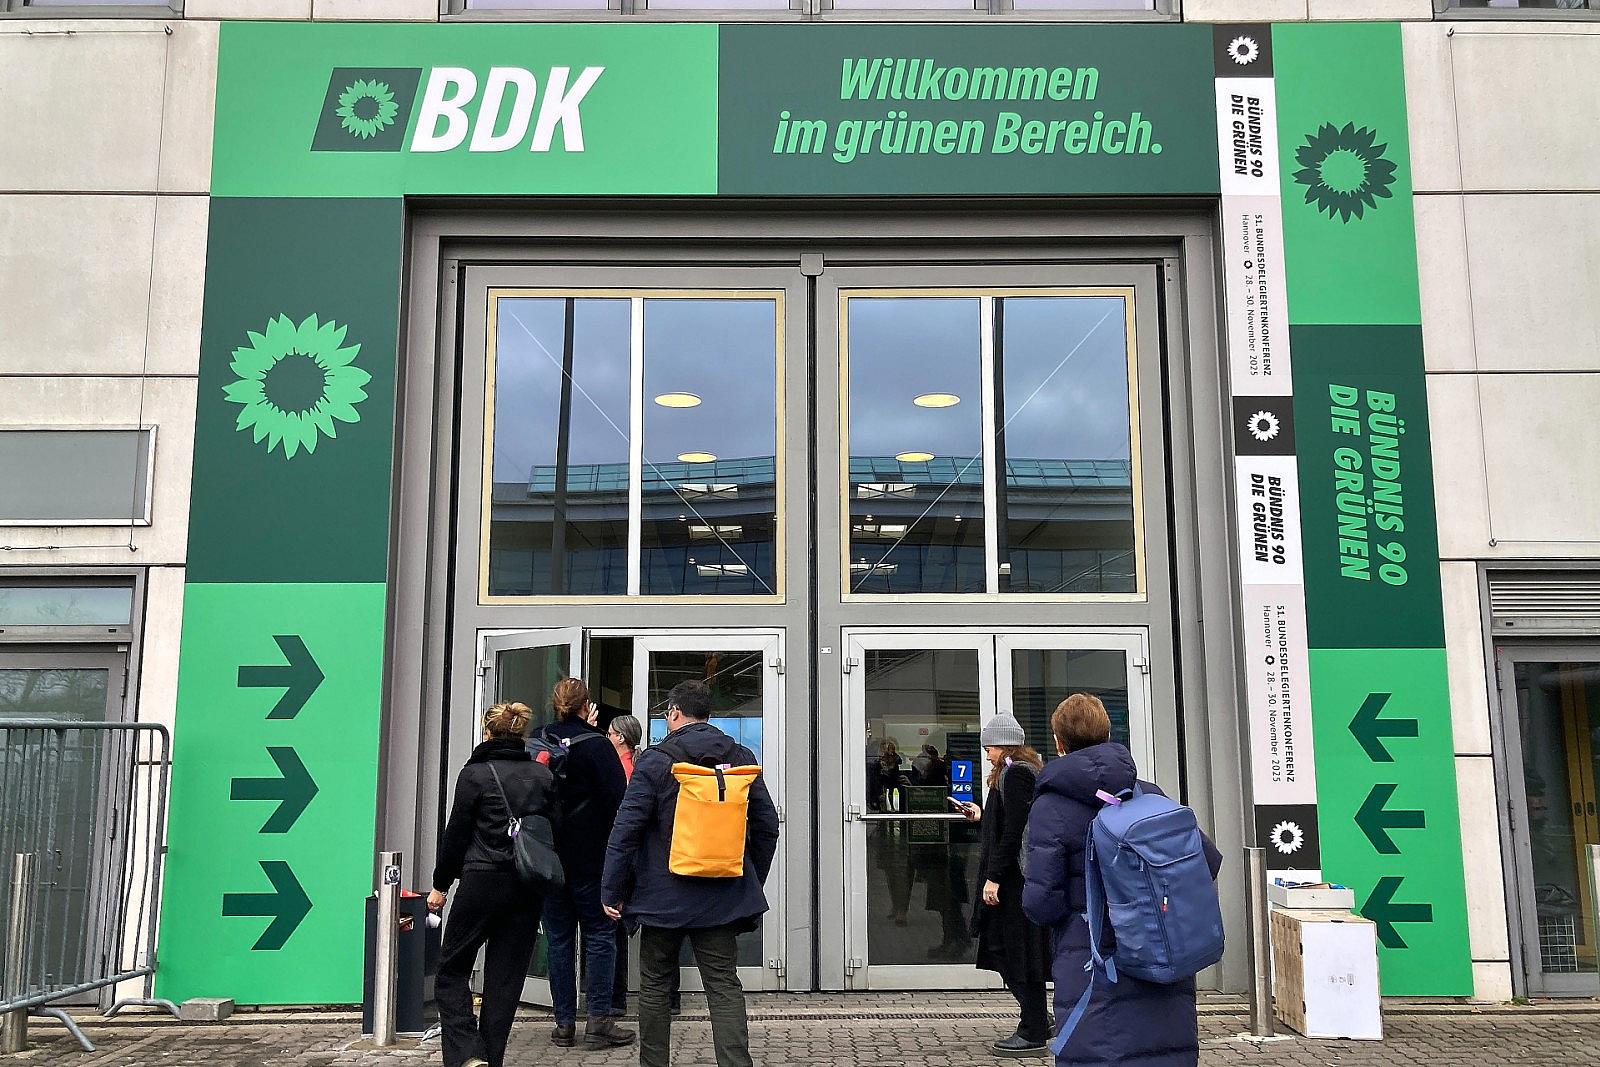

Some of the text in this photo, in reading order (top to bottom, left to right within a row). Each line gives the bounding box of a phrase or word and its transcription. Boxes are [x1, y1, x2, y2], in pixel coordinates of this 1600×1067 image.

[840, 57, 1099, 101] Willkommen
[409, 66, 606, 152] BDK
[772, 110, 1163, 164] im grünen Bereich.
[1231, 94, 1249, 176] DIE GRÜNEN
[1247, 96, 1264, 178] BÜNDNIS 90
[1242, 214, 1250, 254] Hannover
[1245, 275, 1254, 289] 28.
[1246, 294, 1255, 309] 30.
[1255, 214, 1272, 377] 51. BUNDESDELEGIERTENKONFERENZ
[1247, 309, 1257, 353] November
[1250, 355, 1259, 376] 2025
[1328, 383, 1374, 581] DIE GRÜNEN
[1367, 389, 1409, 586] BÜNDNIS 90
[1250, 473, 1271, 563] DIE GRÜNEN
[1268, 475, 1286, 565] BÜNDNIS 90
[1263, 605, 1272, 649] Hannover
[1266, 671, 1276, 686] 28.
[1267, 693, 1277, 708] 30.
[1276, 605, 1295, 783] 51. BUNDESDELEGIERTENKONFERENZ
[1269, 709, 1279, 757] November
[957, 765, 966, 778] 7
[1271, 759, 1281, 783] 2025
